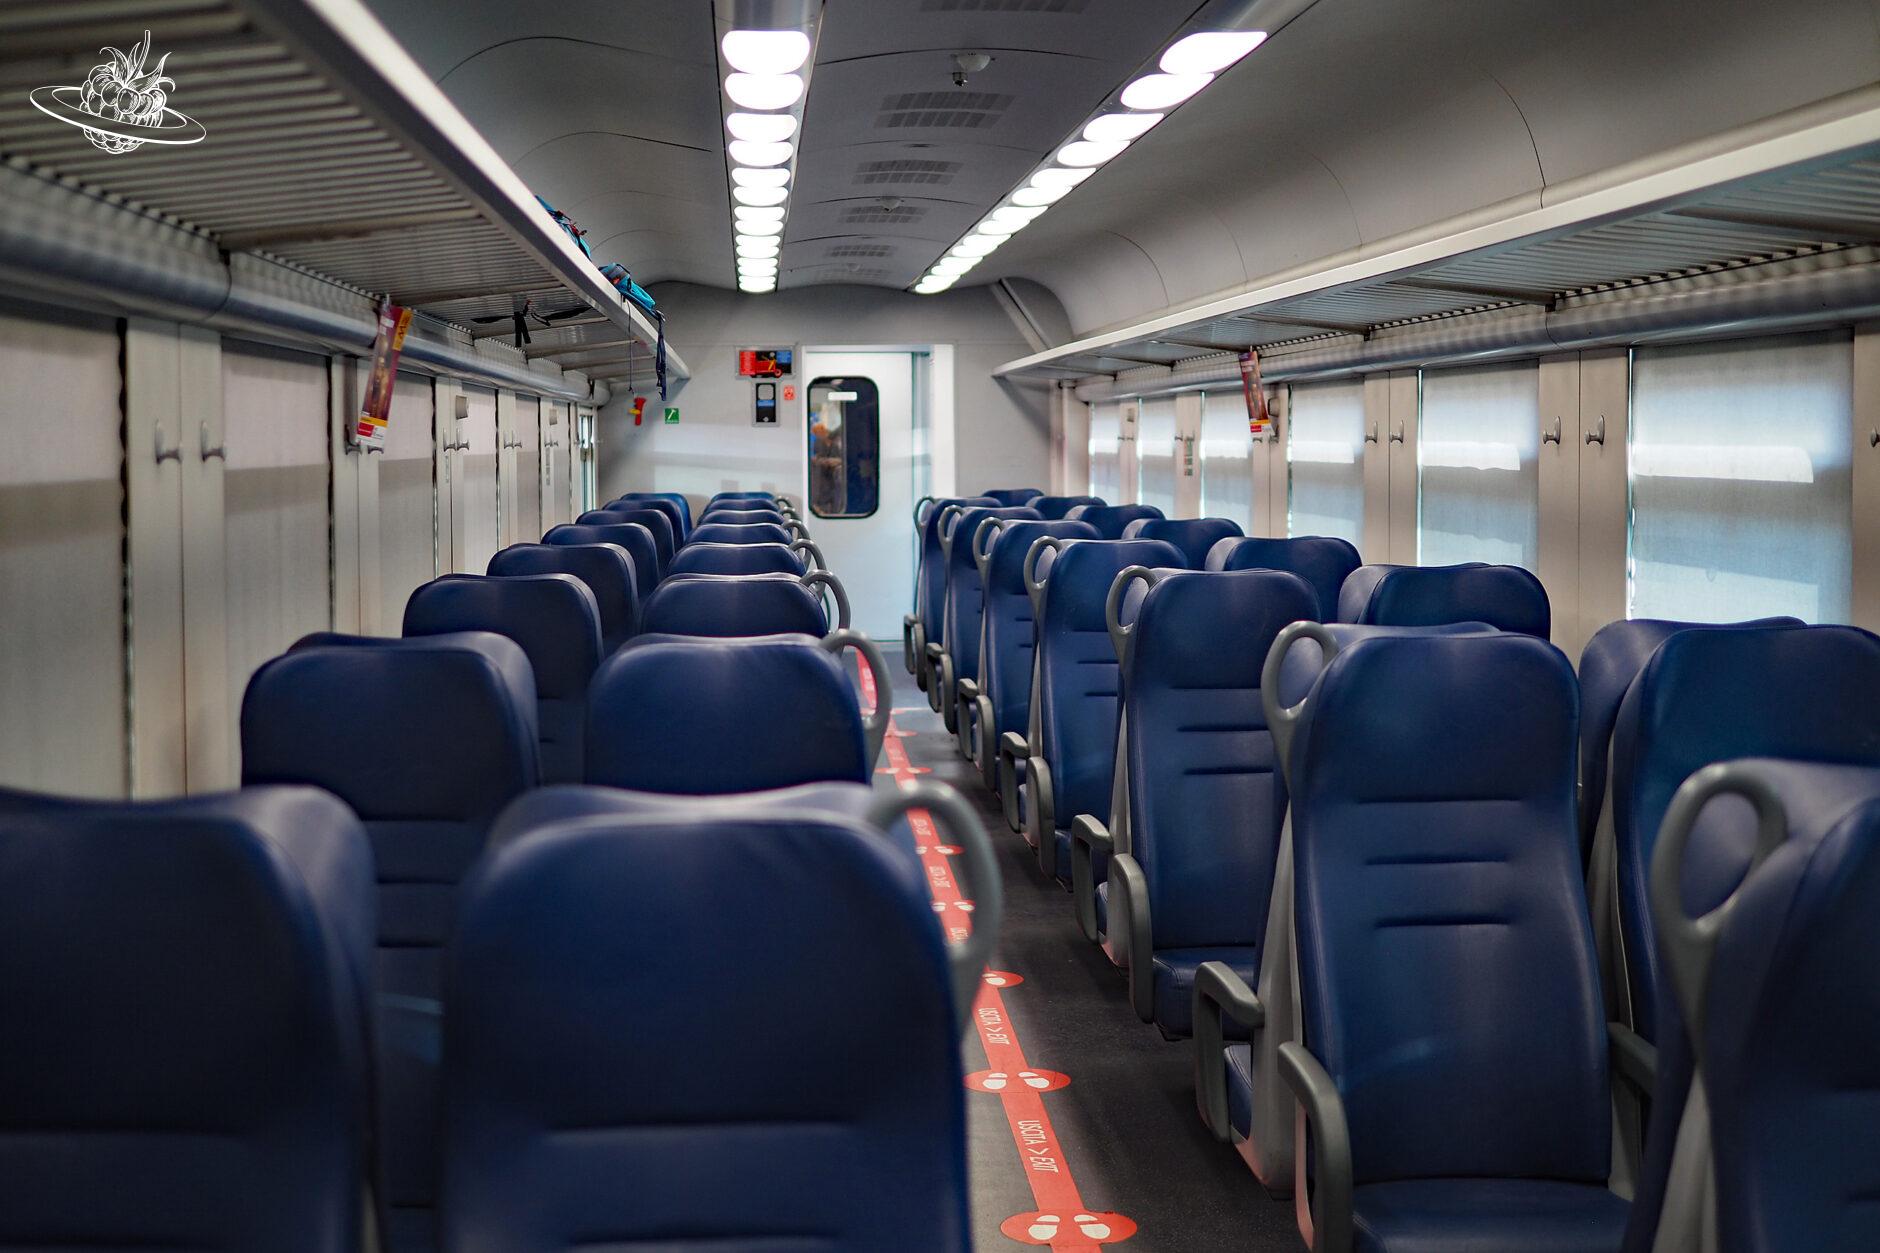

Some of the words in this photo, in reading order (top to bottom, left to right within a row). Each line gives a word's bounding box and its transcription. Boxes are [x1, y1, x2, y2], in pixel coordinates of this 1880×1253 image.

[986, 1033, 1010, 1045] EXIT
[1017, 1119, 1047, 1145] USCITA
[1029, 1156, 1059, 1173] EXIT
